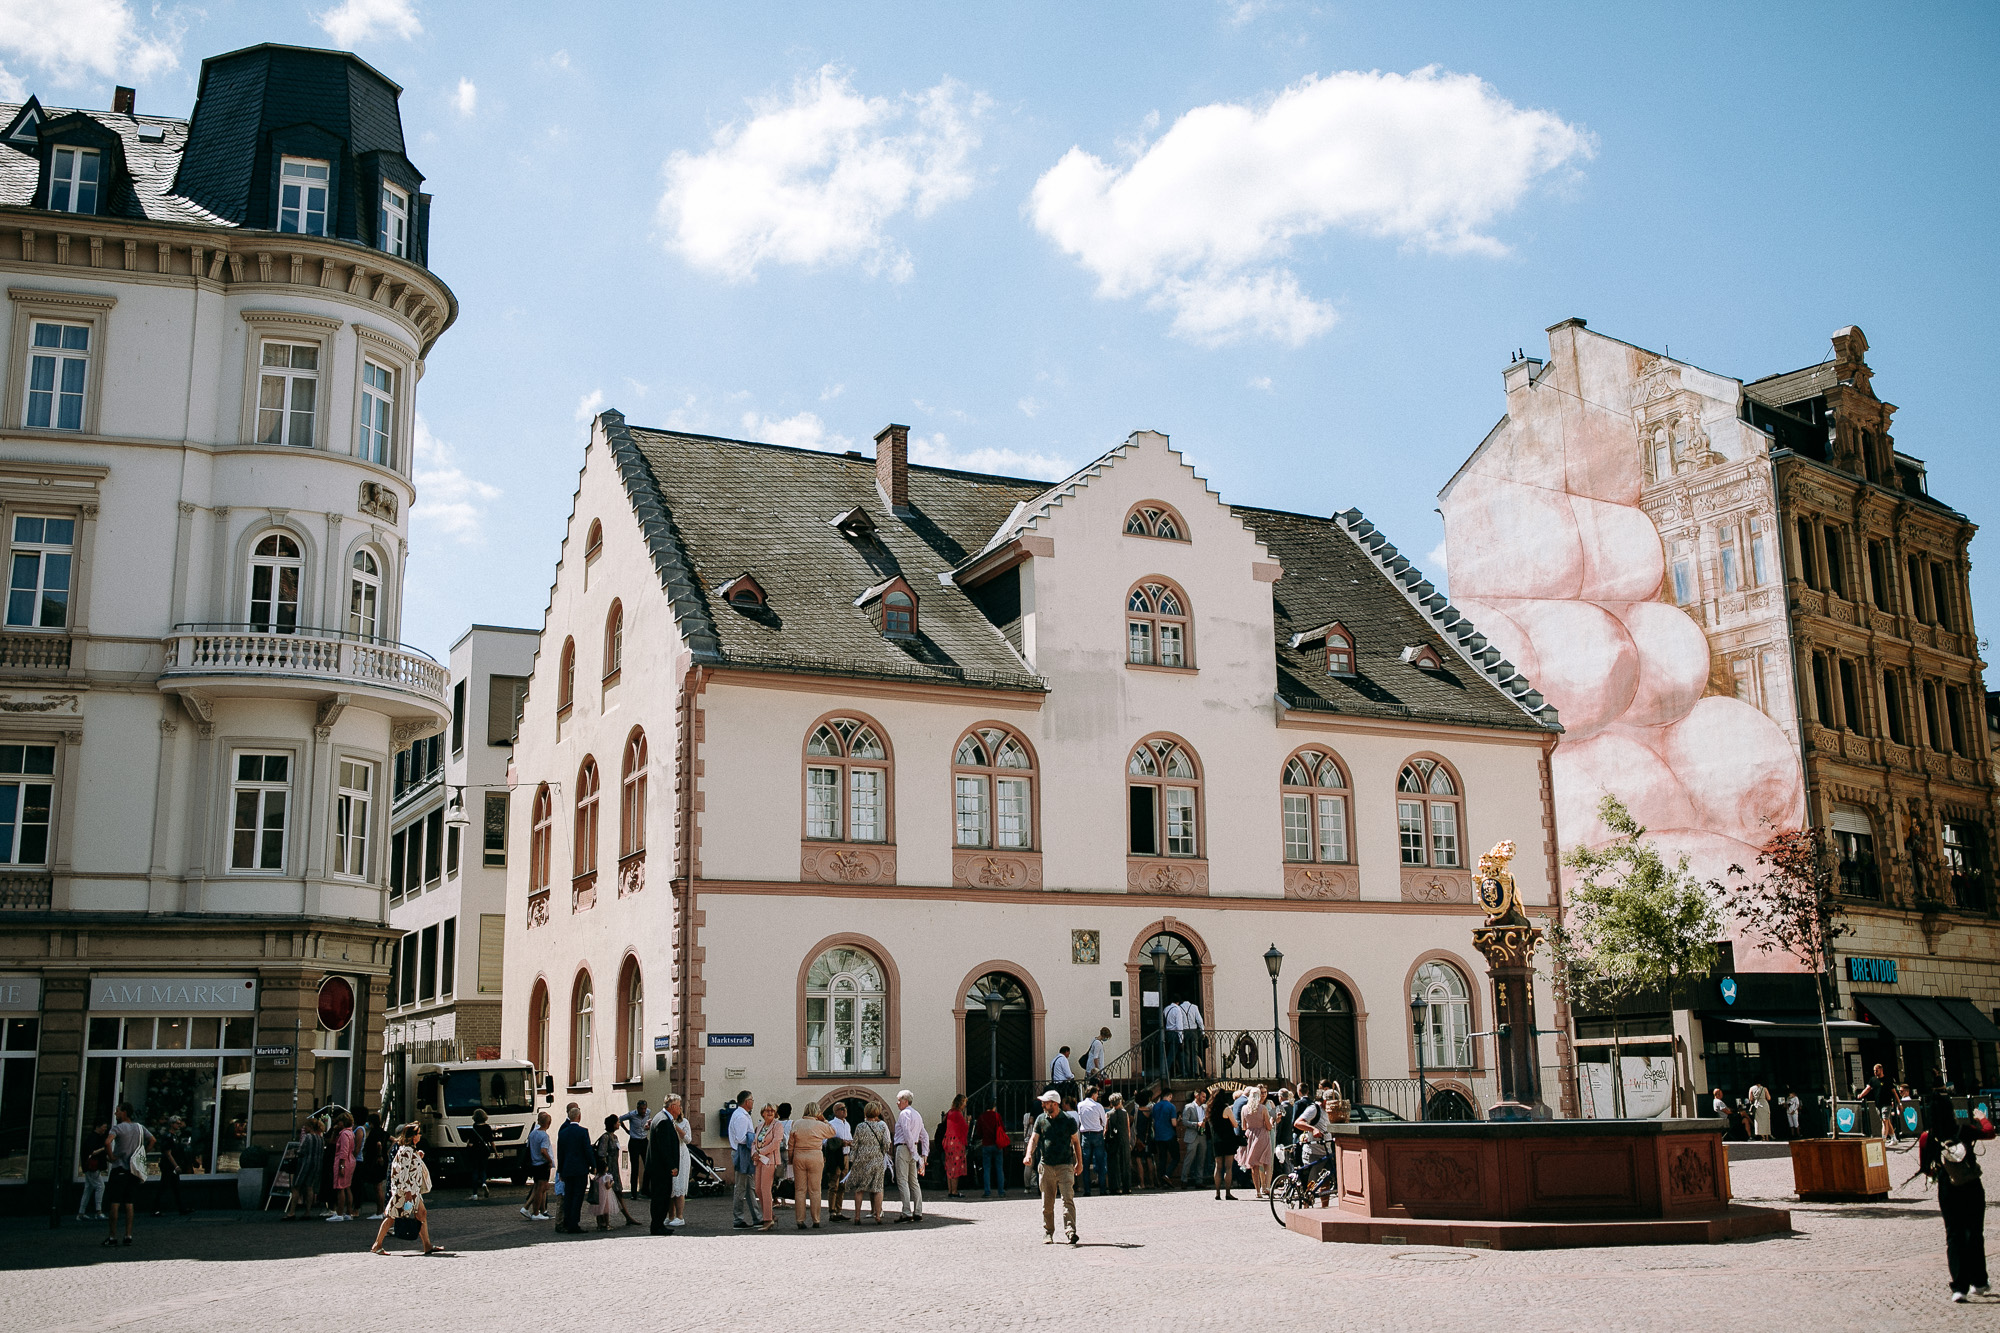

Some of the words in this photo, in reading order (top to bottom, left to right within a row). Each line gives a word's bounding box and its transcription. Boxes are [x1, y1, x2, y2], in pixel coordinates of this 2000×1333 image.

[1851, 957, 1898, 983] BREWDOG
[100, 985, 142, 1003] AM
[151, 985, 243, 1003] MARKT
[711, 1036, 751, 1044] Marktstraße
[257, 1047, 289, 1055] Marktstraße
[158, 1061, 169, 1069] und
[170, 1061, 214, 1069] Kosmetikstudio
